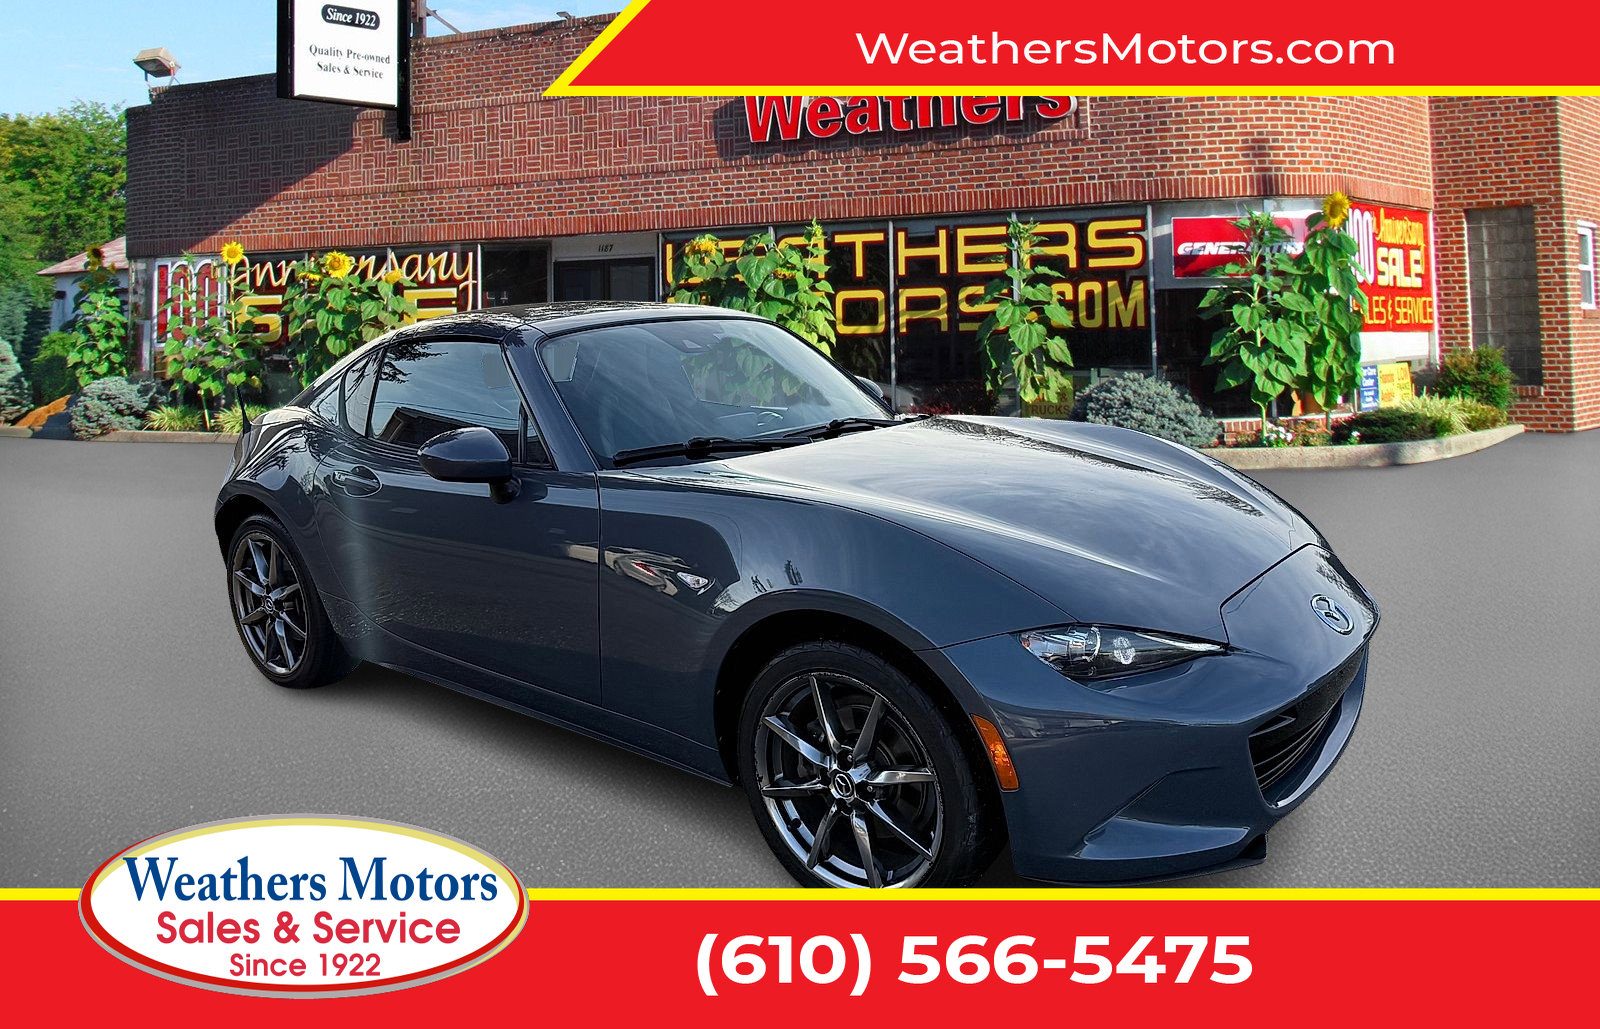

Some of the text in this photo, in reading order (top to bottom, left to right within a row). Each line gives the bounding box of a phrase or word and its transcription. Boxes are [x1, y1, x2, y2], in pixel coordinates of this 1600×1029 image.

[326, 7, 377, 27] Since 1922
[309, 44, 391, 64] Quality Pre-owned
[316, 61, 384, 79] Sales & Service
[744, 96, 1078, 143] Weathers
[1377, 246, 1422, 288] SALE
[1353, 295, 1386, 325] LES
[1394, 296, 1435, 325] SERVICE
